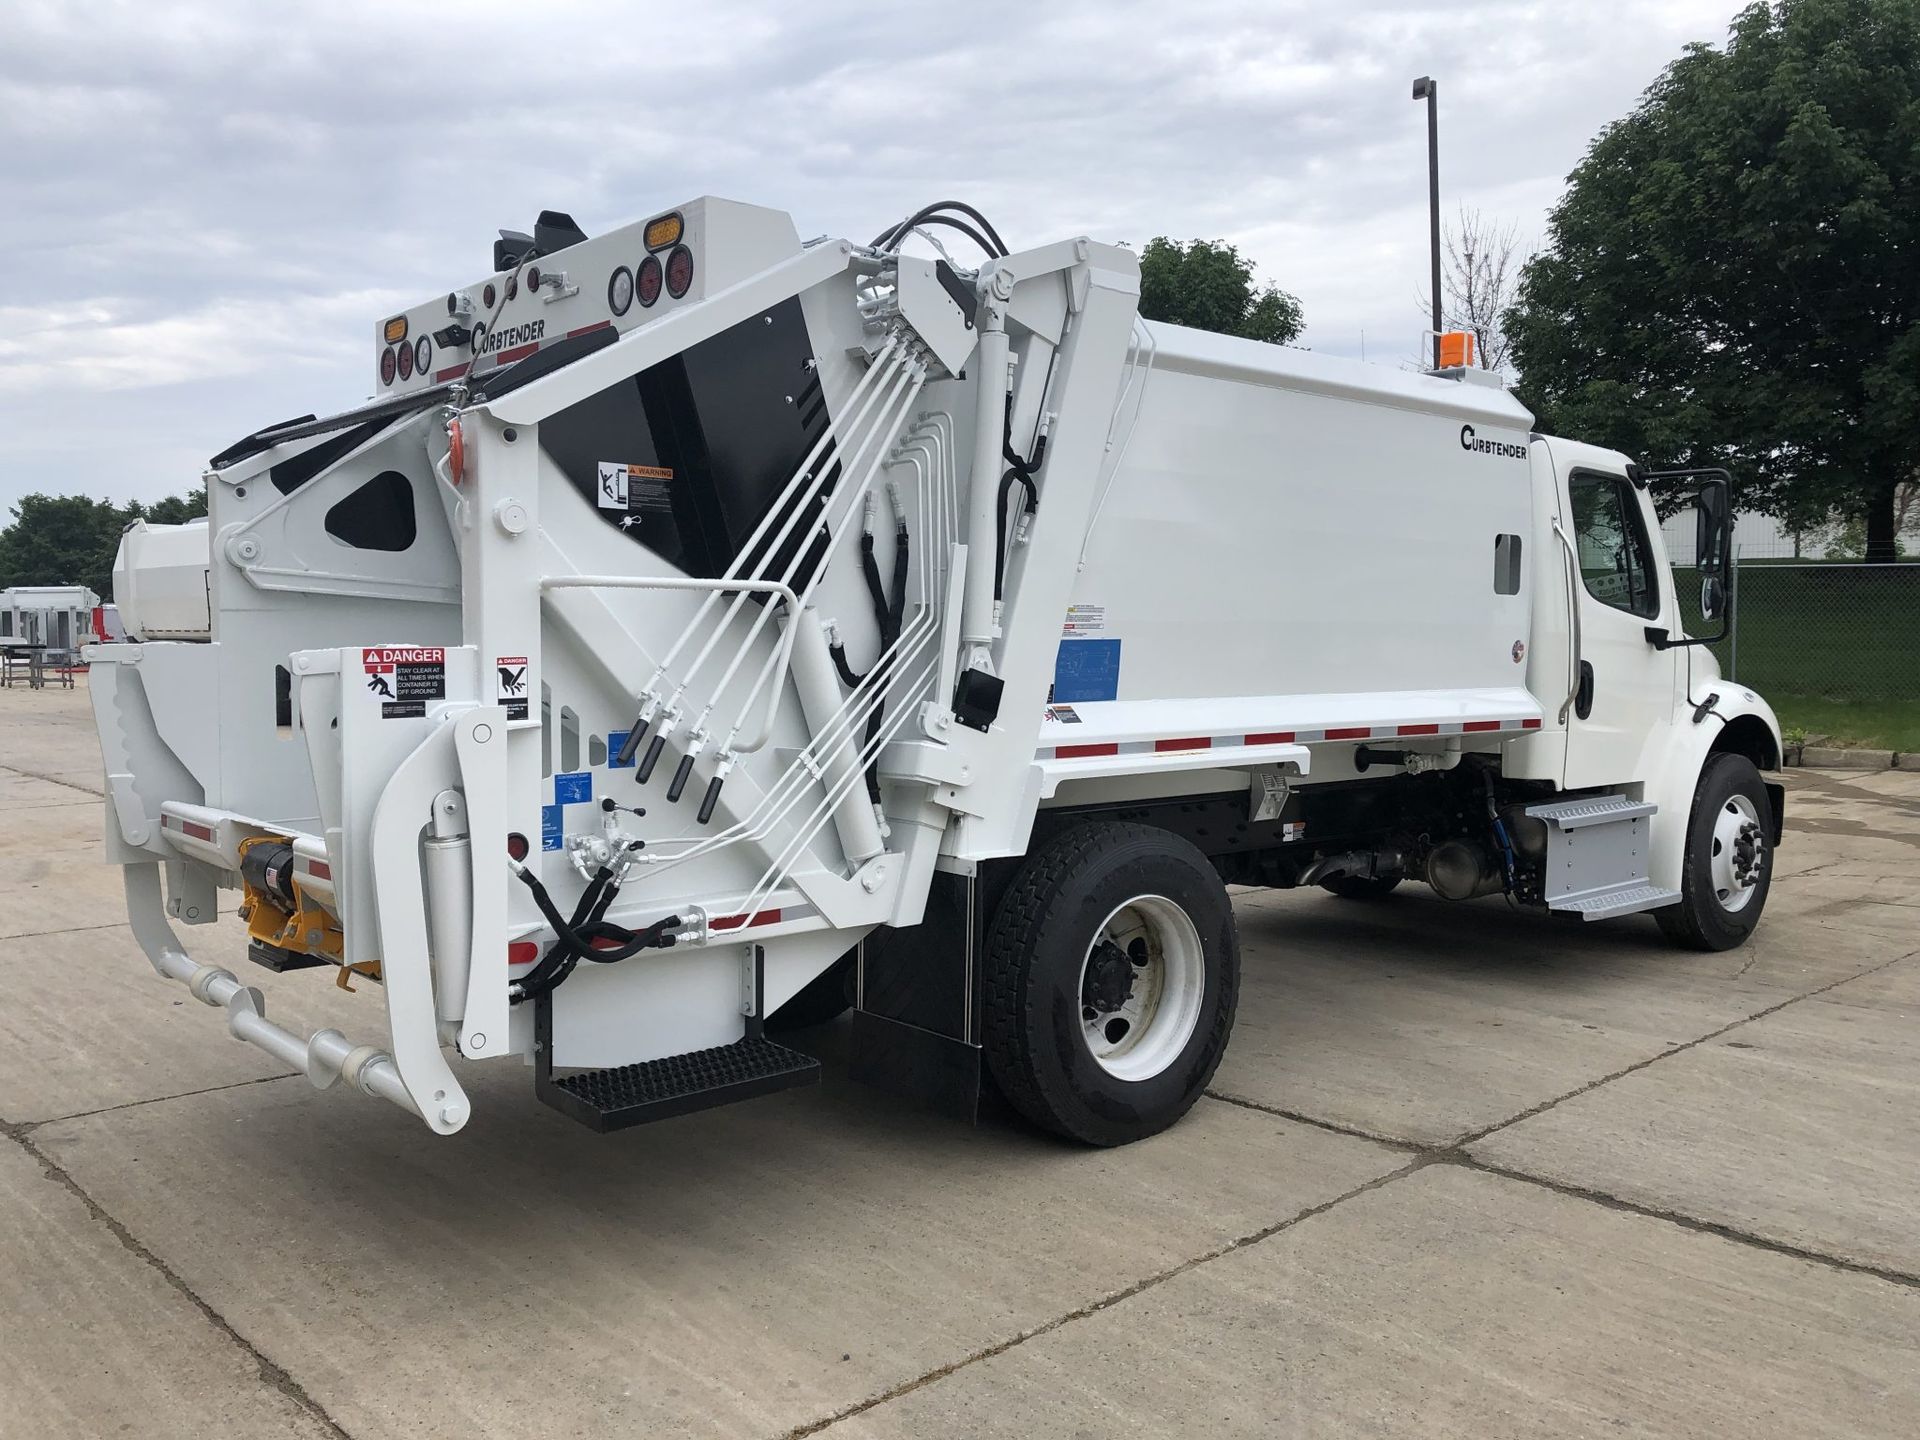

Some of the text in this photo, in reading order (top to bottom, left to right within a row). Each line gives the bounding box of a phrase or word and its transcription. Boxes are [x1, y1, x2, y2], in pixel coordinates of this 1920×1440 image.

[471, 319, 545, 356] CURBTENDER
[1460, 424, 1527, 460] CURBTENDER
[638, 467, 672, 478] WARNING
[383, 650, 442, 662] DANGER
